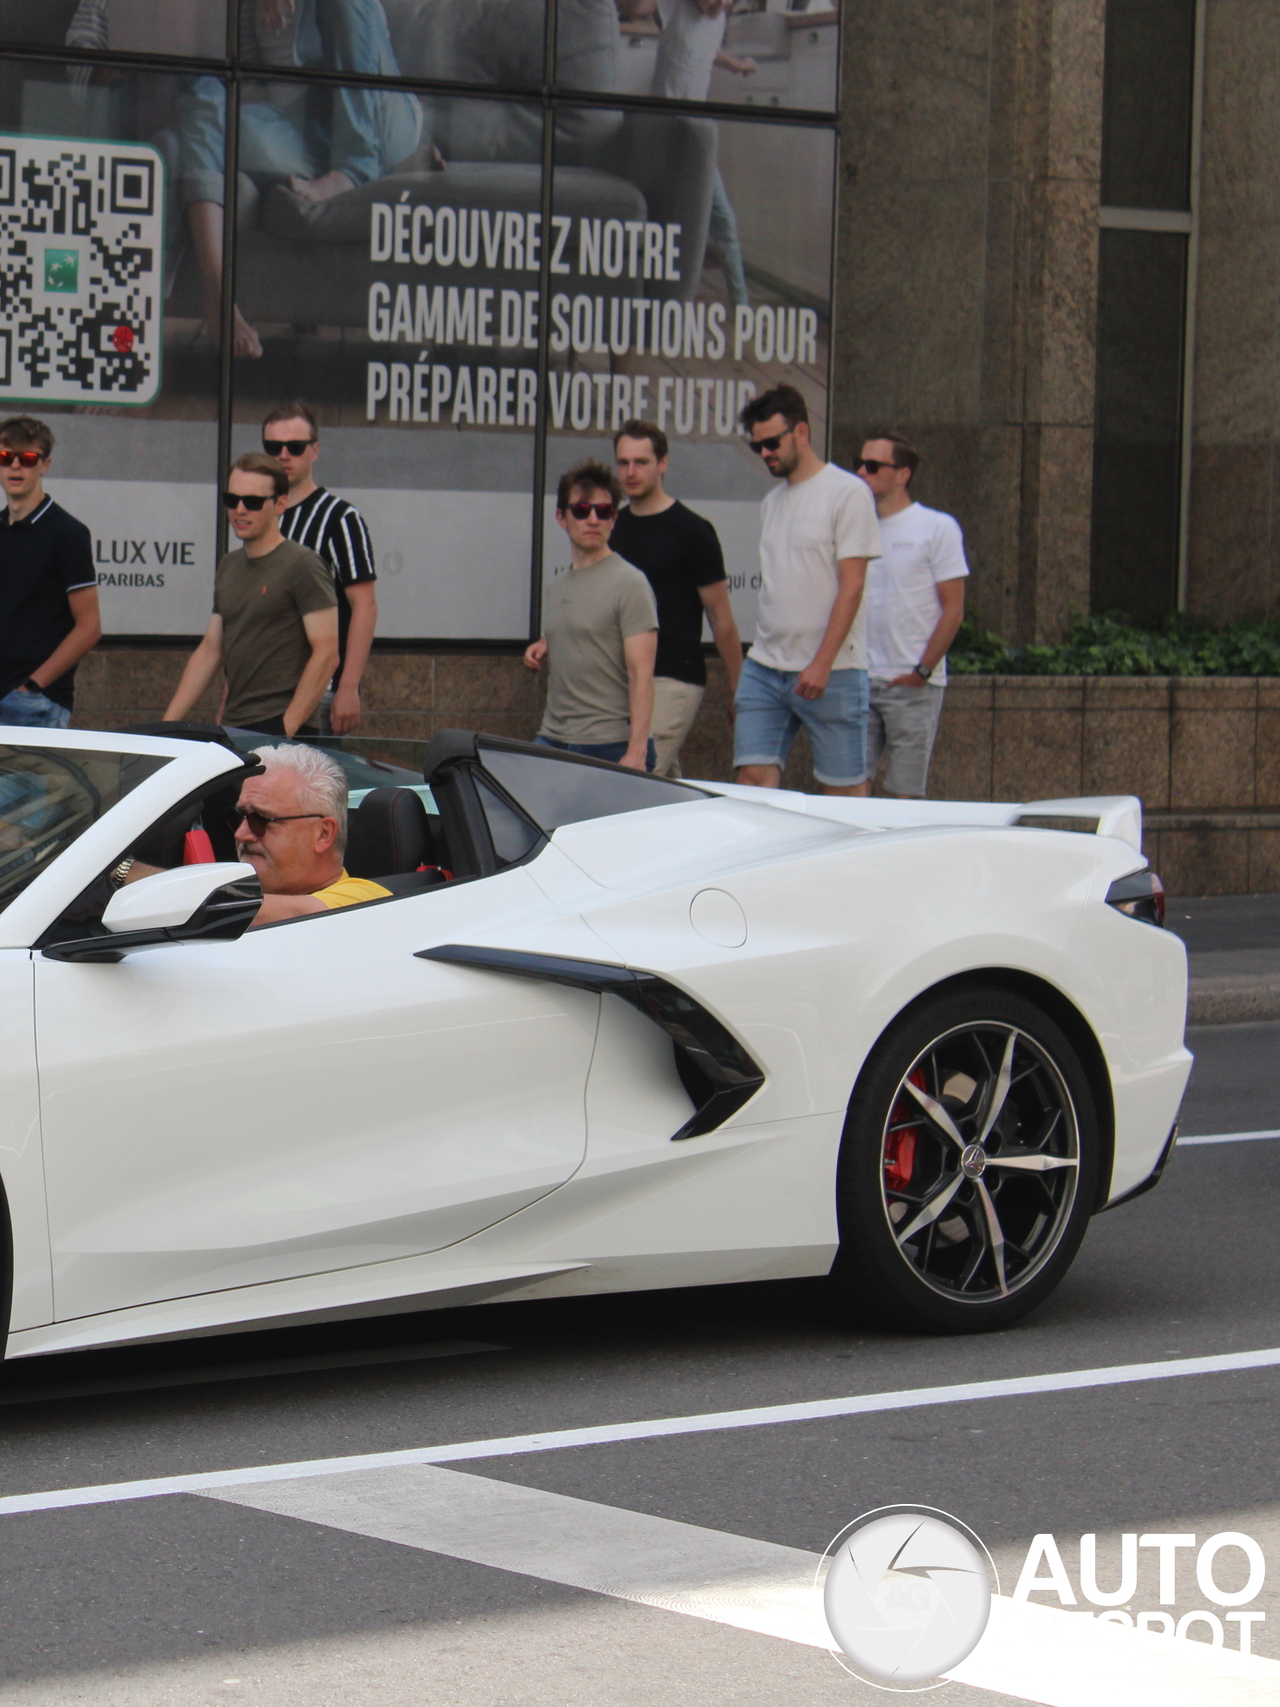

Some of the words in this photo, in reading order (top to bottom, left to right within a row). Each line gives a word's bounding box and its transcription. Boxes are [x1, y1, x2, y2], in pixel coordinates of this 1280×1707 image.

[370, 191, 570, 274] DÉCOUVREZ
[579, 218, 681, 281] NOTRE
[367, 282, 493, 347] GAMME
[500, 290, 538, 349] DE
[550, 293, 726, 359] SOLUTIONS
[734, 306, 818, 364] POUR
[366, 352, 538, 427] PRÉPARER
[548, 371, 649, 430] VOTRE
[96, 539, 147, 564] LUX
[154, 541, 195, 565] VIE
[97, 573, 164, 588] PARIBAS
